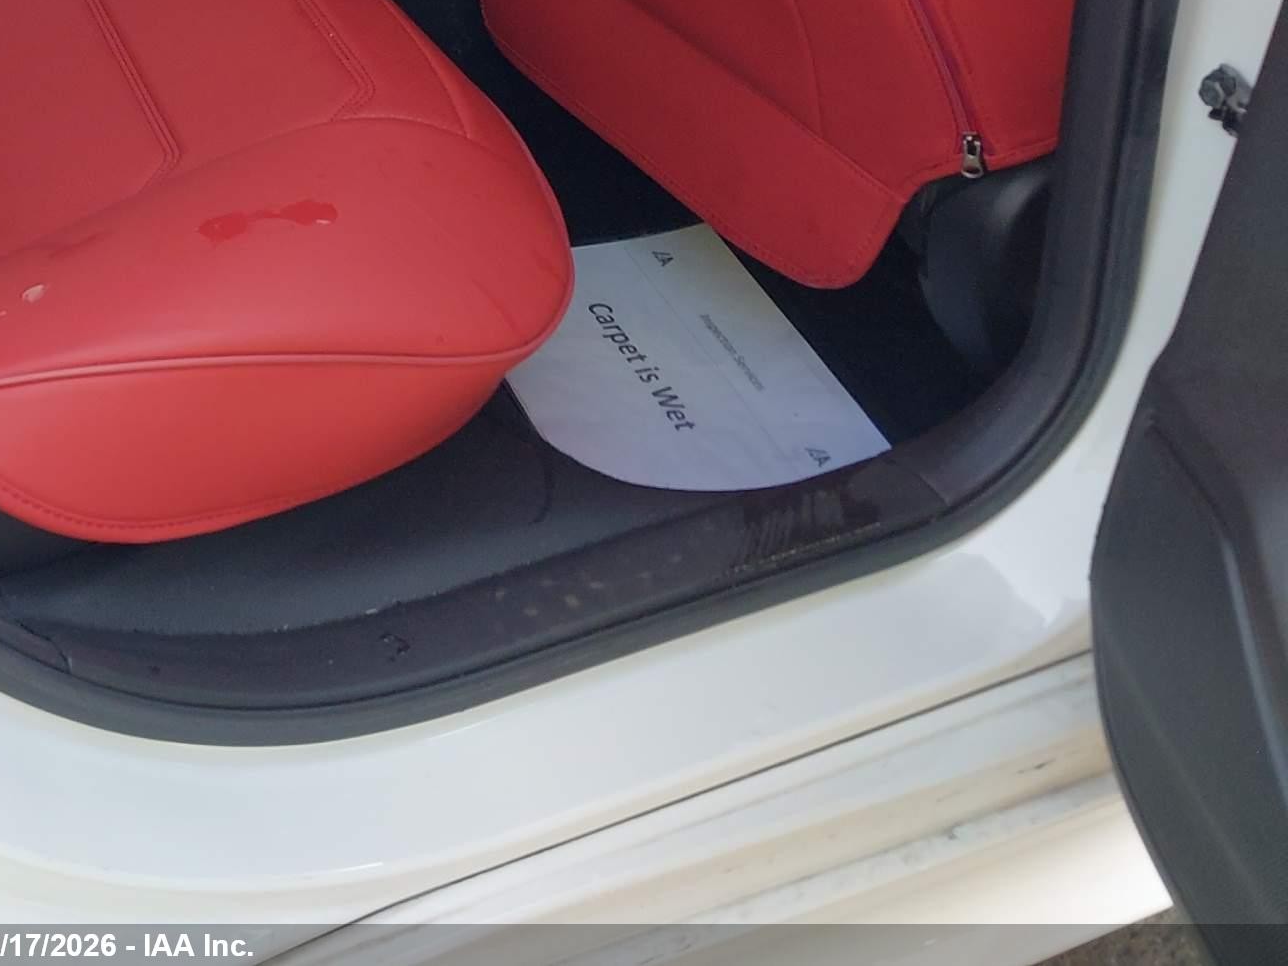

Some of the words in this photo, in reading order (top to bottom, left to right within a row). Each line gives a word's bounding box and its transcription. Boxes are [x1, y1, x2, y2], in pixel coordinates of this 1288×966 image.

[588, 303, 647, 364] Carpet
[634, 366, 661, 384] is
[651, 386, 697, 432] Wet
